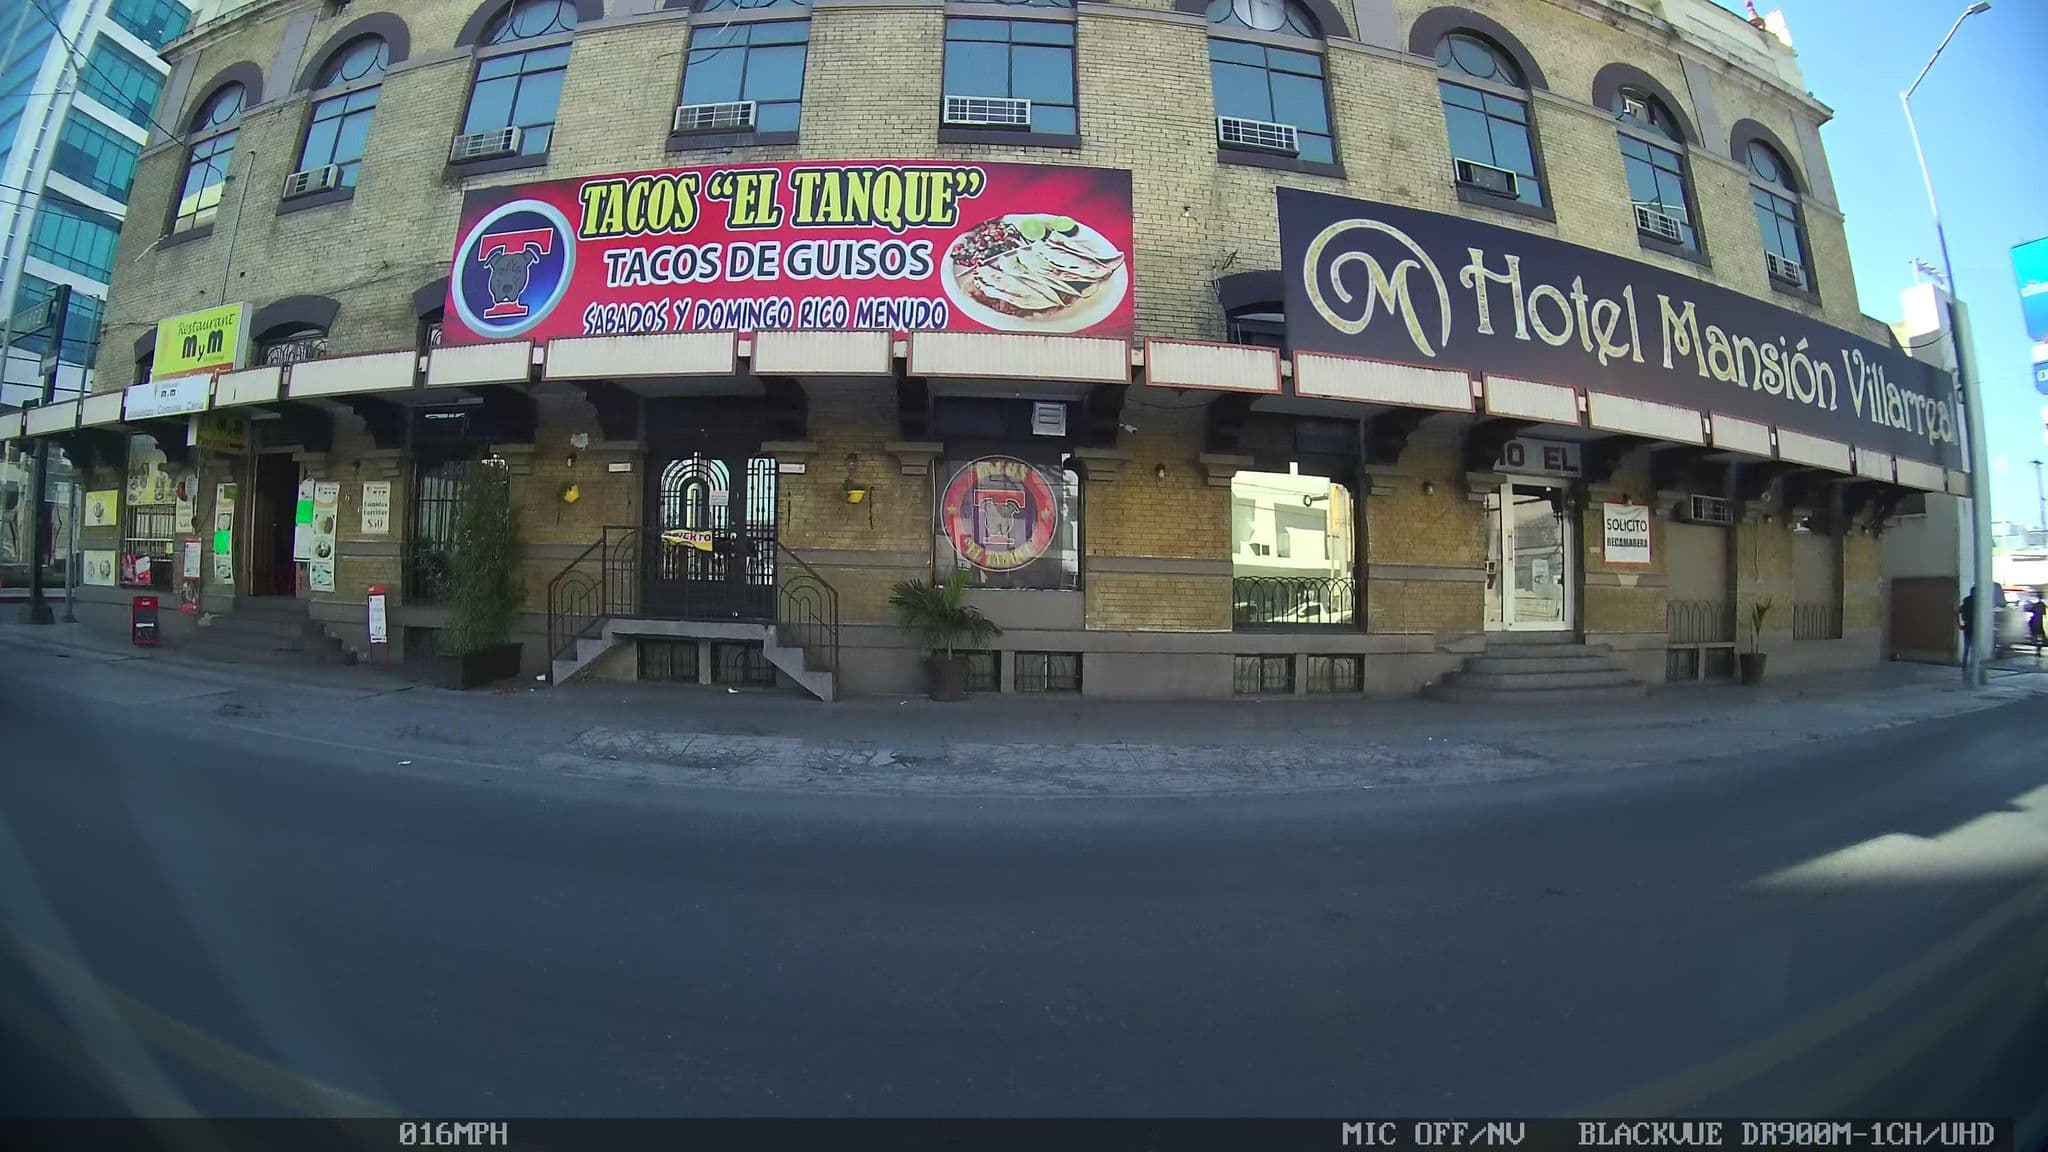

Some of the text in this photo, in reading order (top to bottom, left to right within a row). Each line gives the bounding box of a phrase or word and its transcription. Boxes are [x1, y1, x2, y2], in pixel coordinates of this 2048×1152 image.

[579, 170, 701, 238] TACOS
[605, 242, 932, 286] TACOS DE GUISOS
[178, 314, 236, 336] Restaurant
[583, 298, 949, 334] SABADOS Y DOMINGO RICO MENUDO
[1460, 248, 1646, 366] Hotel
[1657, 295, 1838, 411] Mansión
[1606, 518, 1648, 532] SOLICITO
